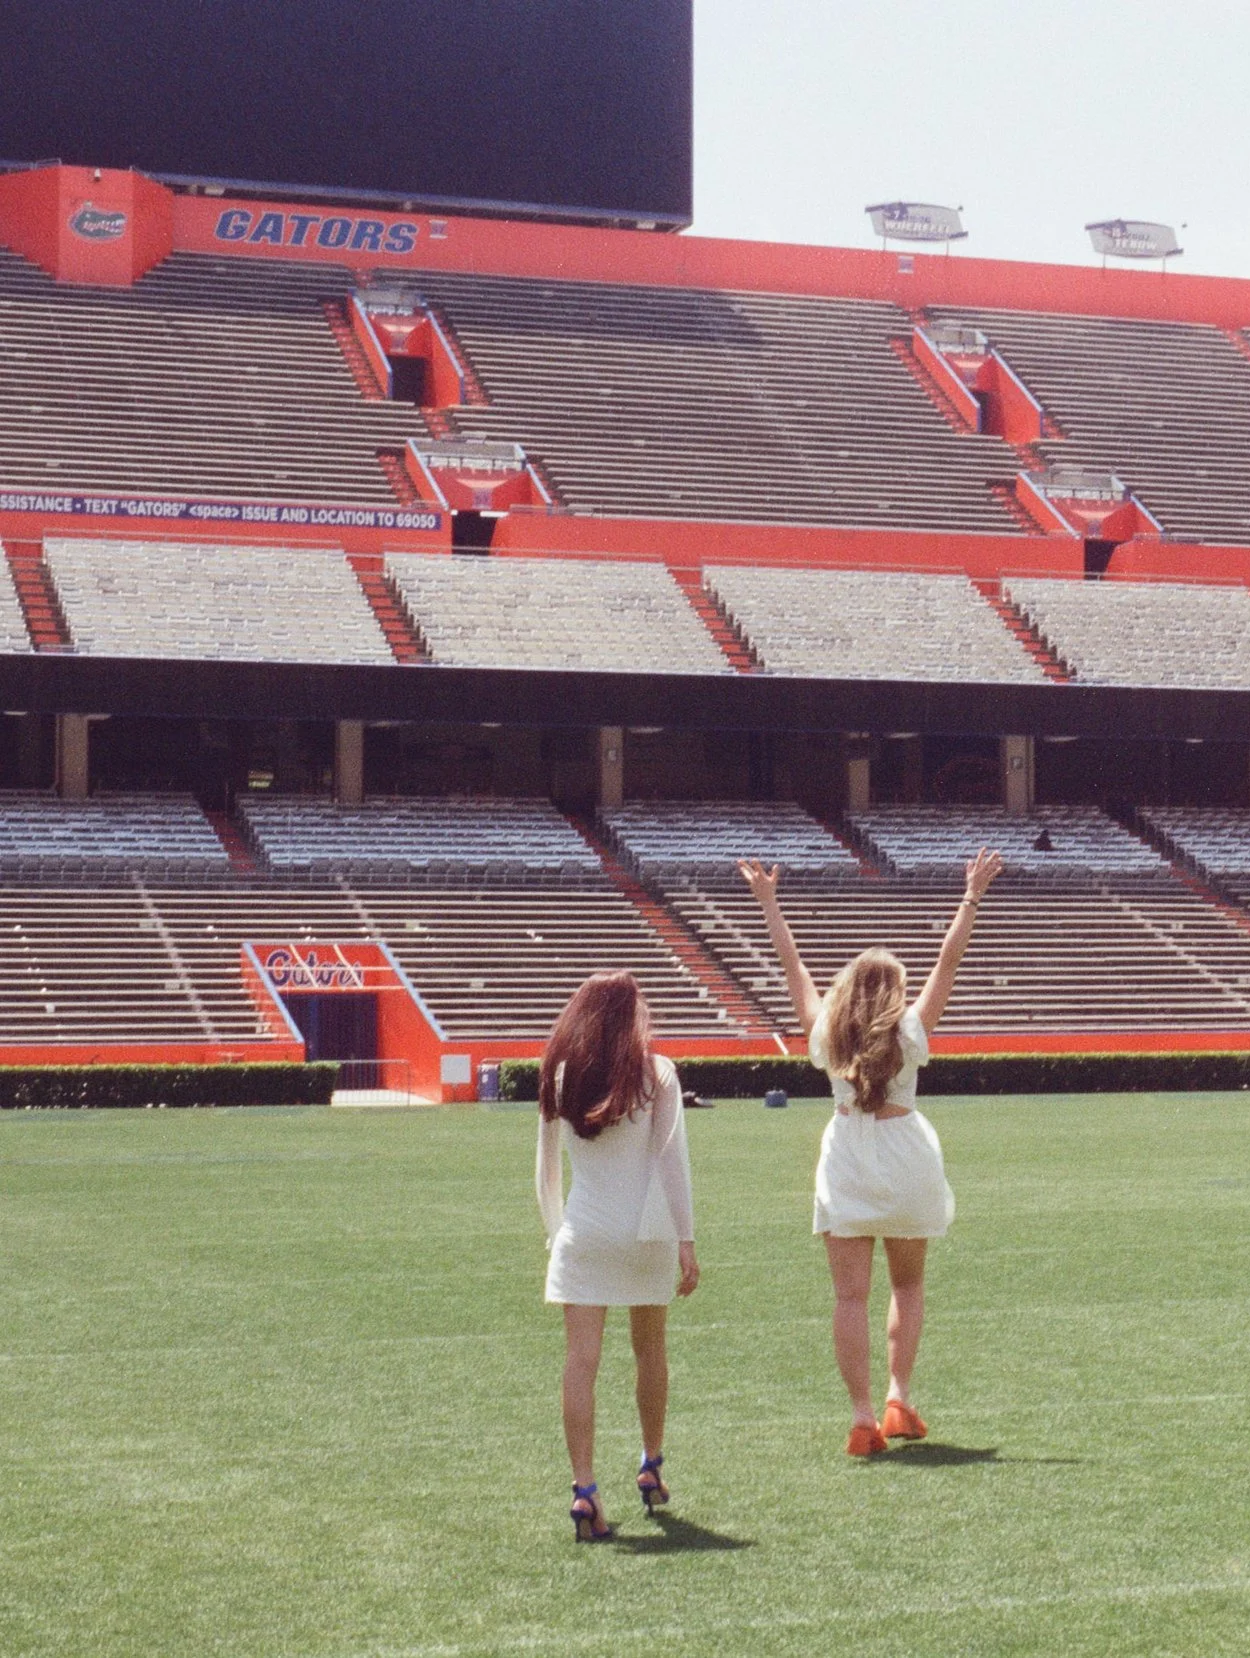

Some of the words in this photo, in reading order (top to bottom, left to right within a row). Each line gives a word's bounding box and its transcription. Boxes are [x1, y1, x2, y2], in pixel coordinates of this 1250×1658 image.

[214, 208, 420, 254] GATORS
[84, 499, 117, 514] TEXT
[188, 504, 239, 519] <space>
[242, 506, 277, 521] ISSUE
[281, 508, 308, 523] AND
[311, 510, 375, 526] LOCATION
[378, 512, 393, 526] TO
[266, 949, 364, 988] Gators
